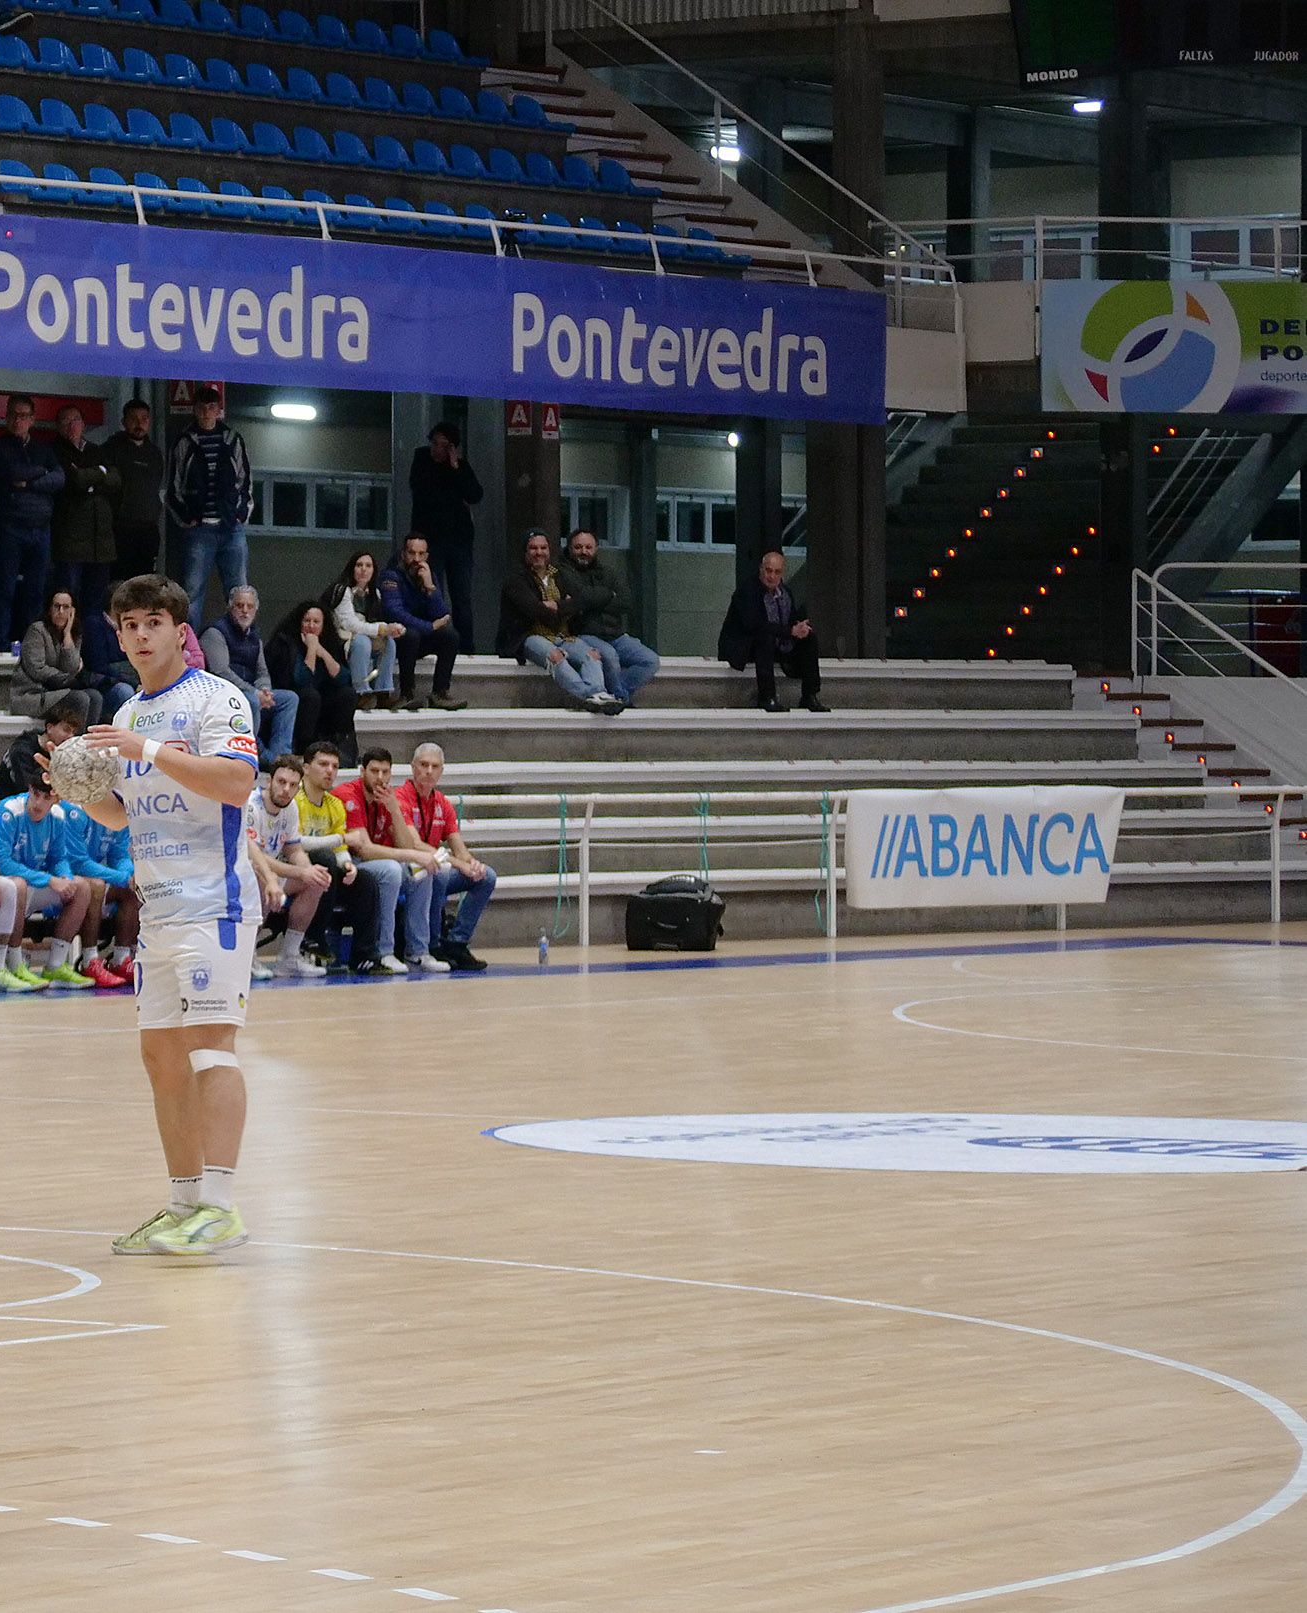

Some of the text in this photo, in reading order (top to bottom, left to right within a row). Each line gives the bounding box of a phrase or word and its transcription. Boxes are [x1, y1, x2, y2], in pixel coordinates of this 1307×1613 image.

[1179, 50, 1214, 62] FALTAS
[1253, 50, 1299, 62] JUGADOR
[1026, 68, 1078, 83] MONDO
[1260, 319, 1307, 335] DE
[511, 291, 828, 396] Pontevedra
[512, 403, 528, 424] A
[545, 407, 557, 427] A
[136, 711, 165, 727] ence
